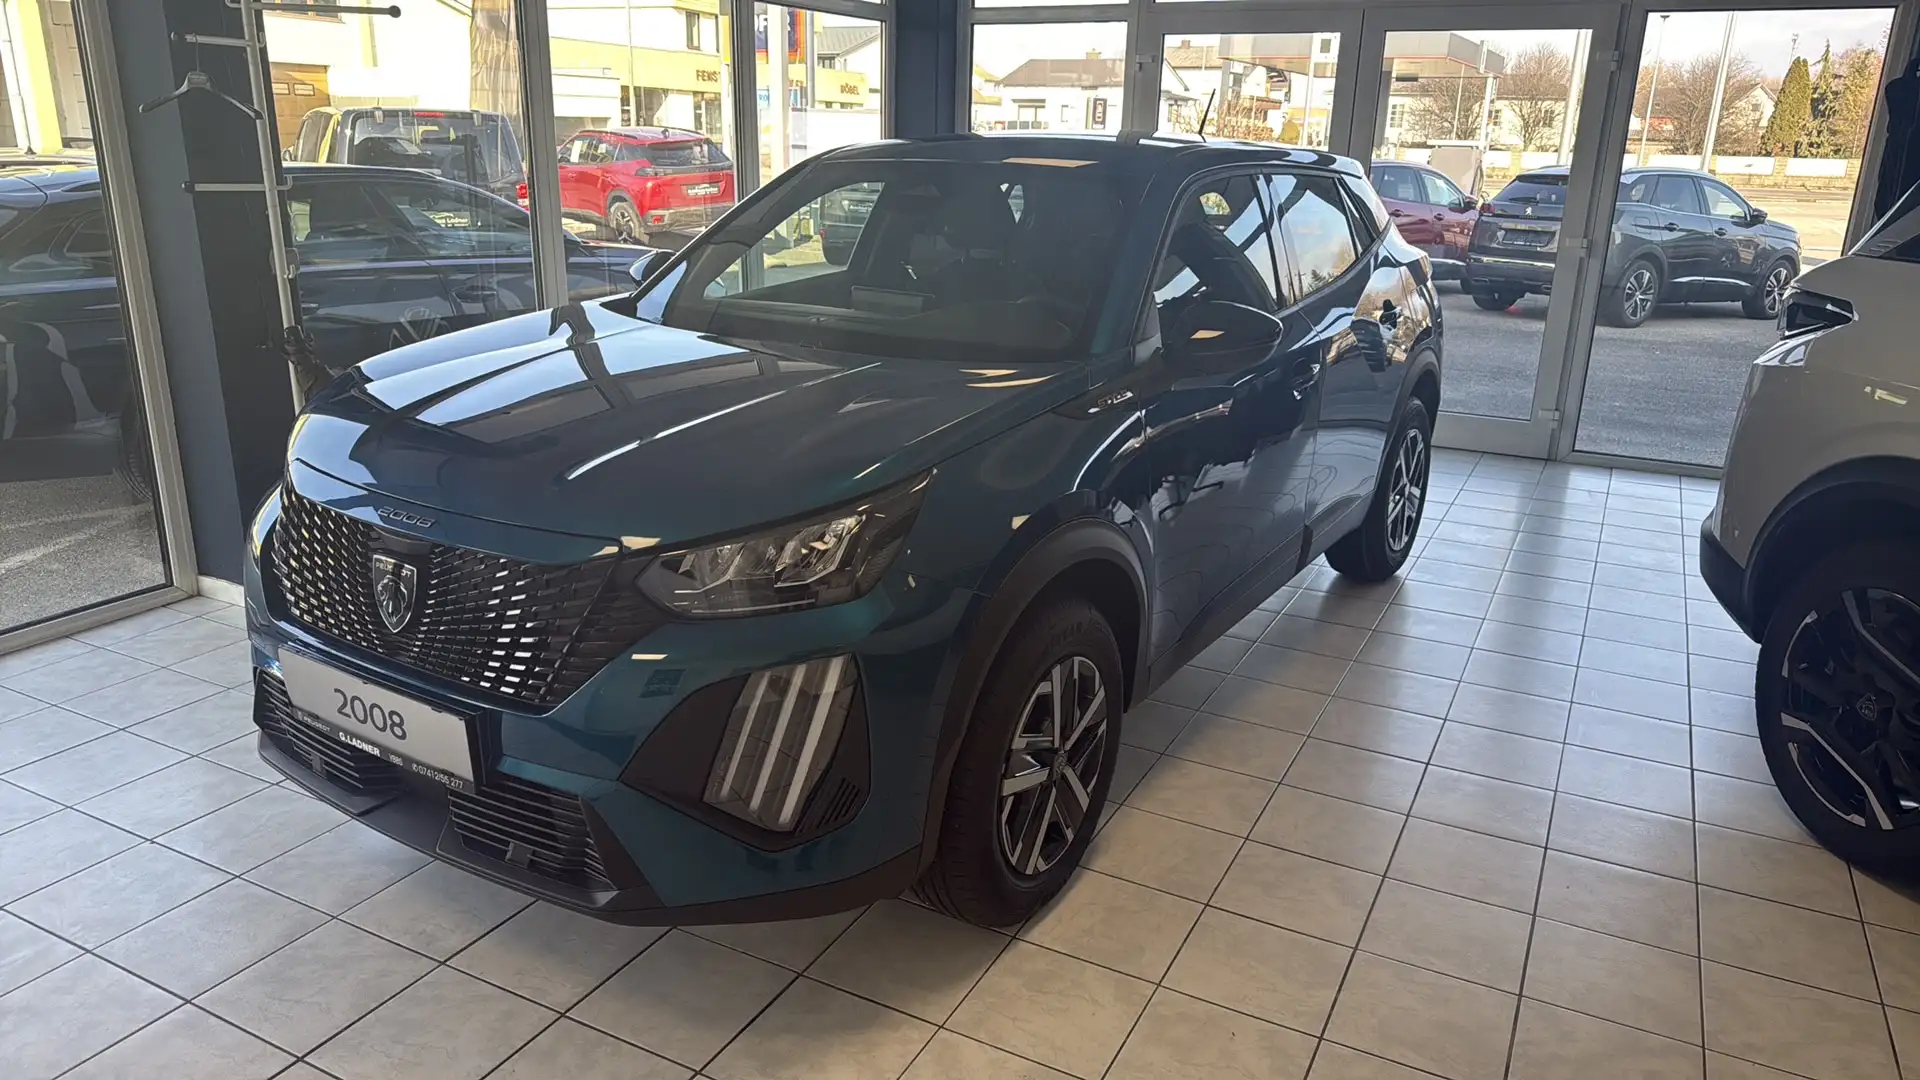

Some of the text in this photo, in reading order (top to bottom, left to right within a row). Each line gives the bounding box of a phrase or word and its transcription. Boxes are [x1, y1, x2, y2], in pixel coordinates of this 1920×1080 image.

[377, 506, 436, 528] 2008
[375, 561, 412, 578] PEUGOT
[333, 687, 408, 741] 2008
[338, 731, 381, 757] G.LADNER
[450, 777, 464, 789] 277
